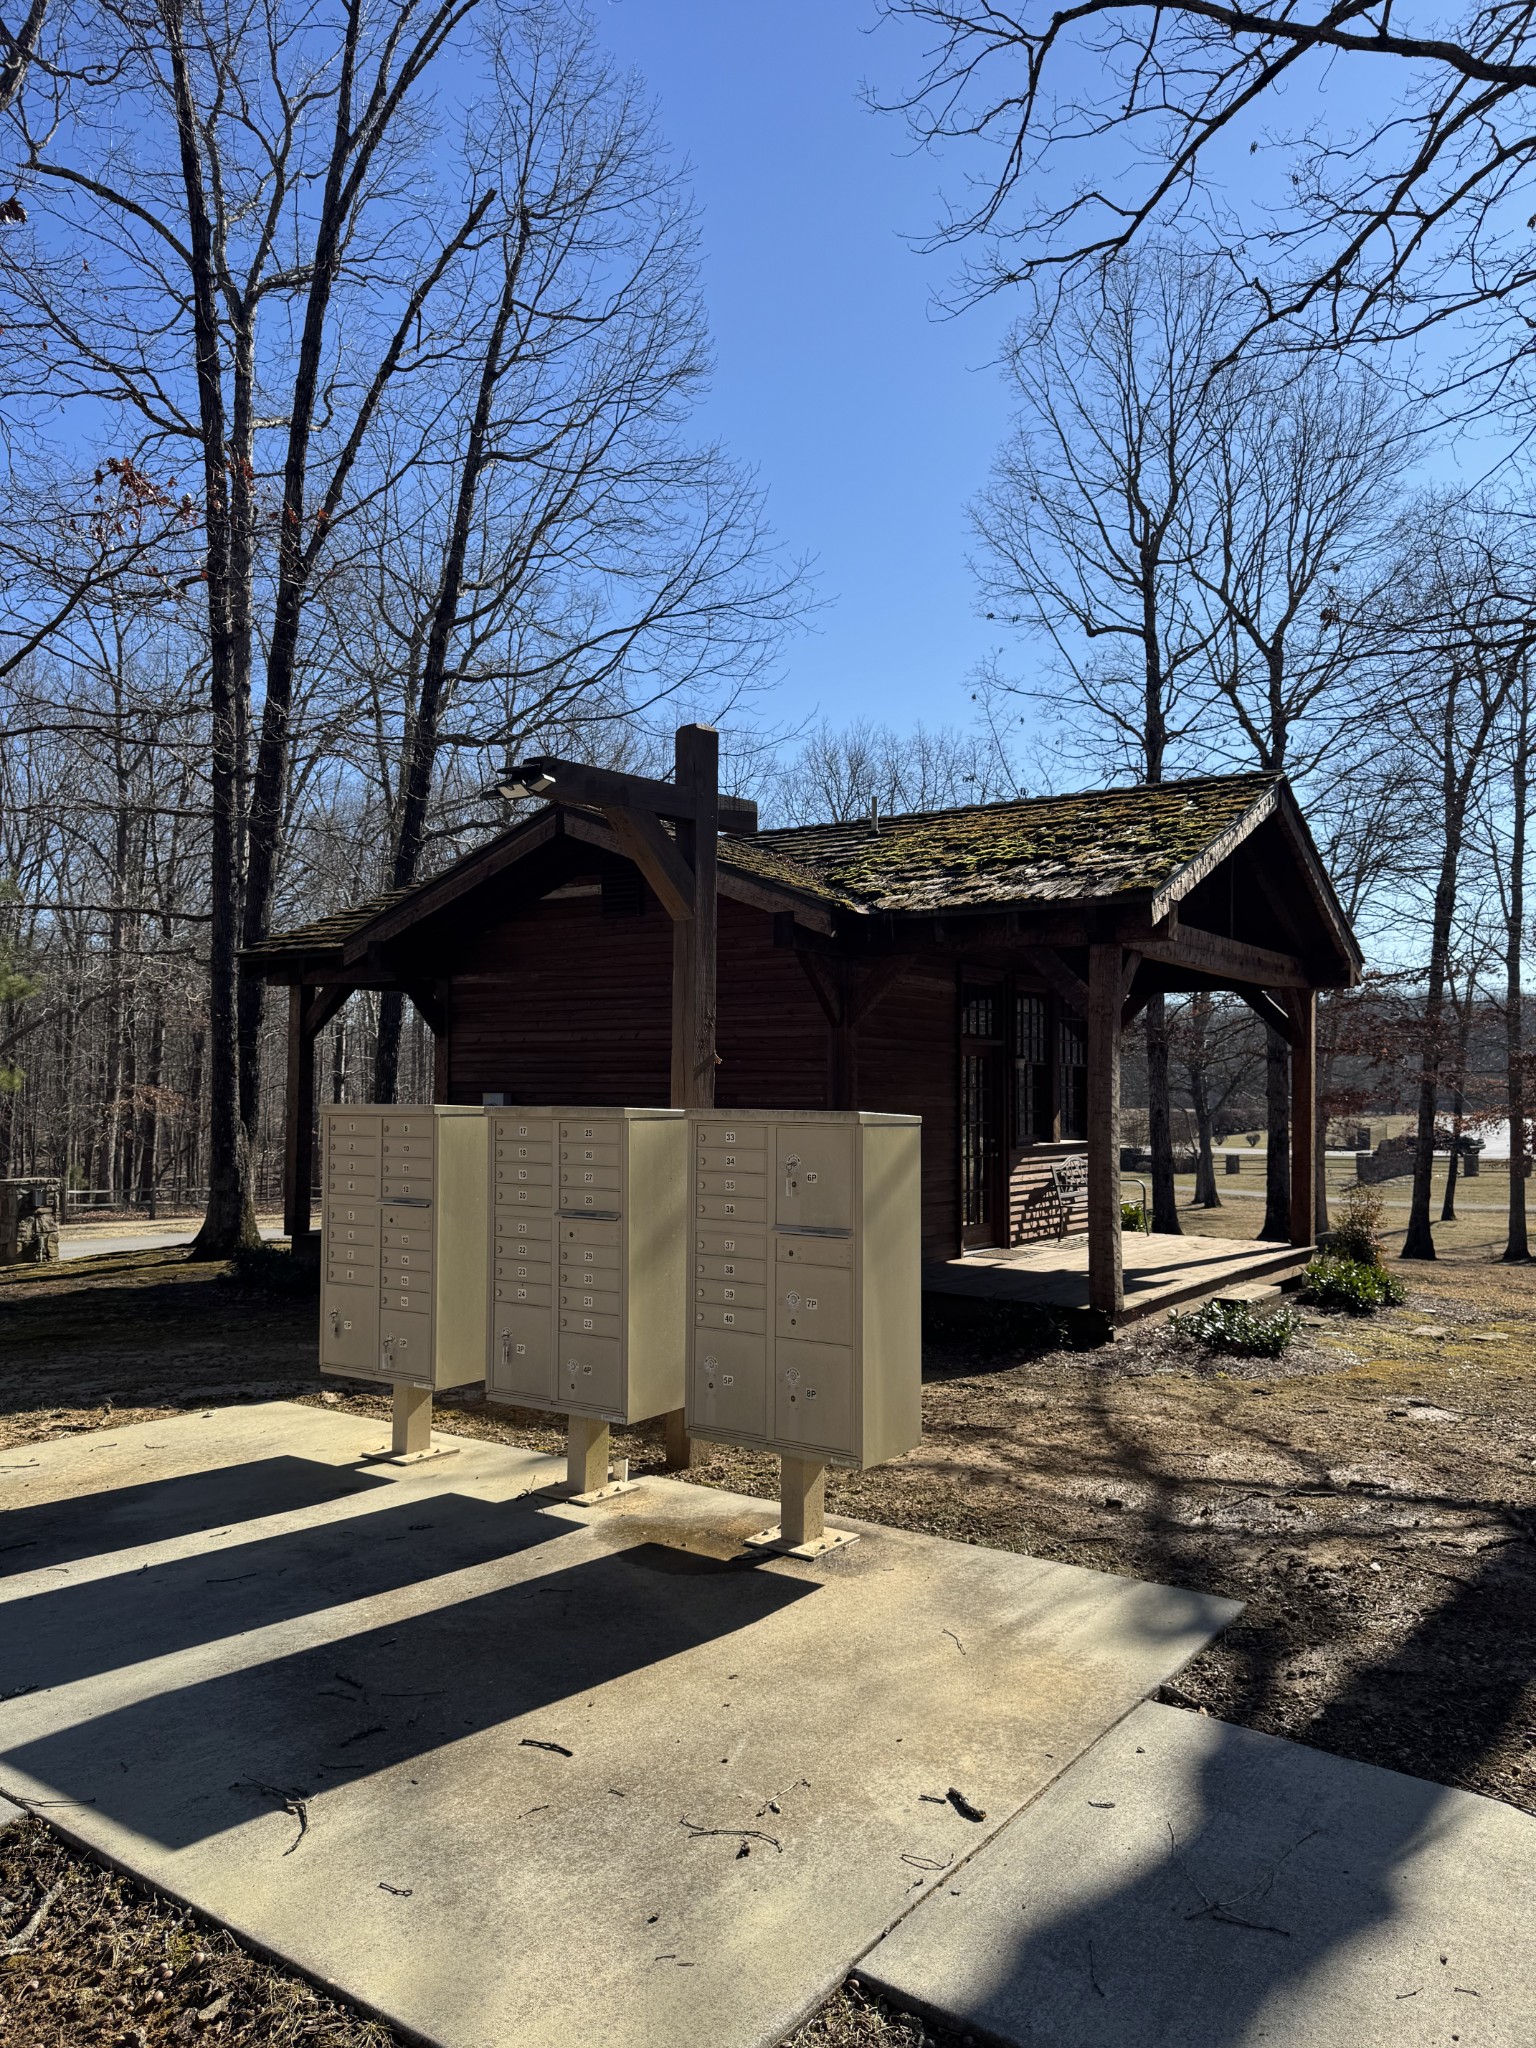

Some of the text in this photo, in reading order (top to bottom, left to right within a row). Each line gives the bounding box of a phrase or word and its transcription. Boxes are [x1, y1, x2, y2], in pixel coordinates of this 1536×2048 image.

[726, 1133, 735, 1141] 33
[726, 1157, 735, 1165] 34
[807, 1174, 817, 1182] 6P
[725, 1205, 734, 1213] 36
[725, 1242, 734, 1250] 37
[518, 1268, 526, 1276] 23
[725, 1266, 734, 1274] 38
[725, 1290, 734, 1298] 39
[806, 1300, 817, 1308] 7P
[724, 1315, 733, 1323] 40
[517, 1345, 525, 1353] 3P
[723, 1376, 733, 1385] 5P
[806, 1390, 817, 1398] 8P
